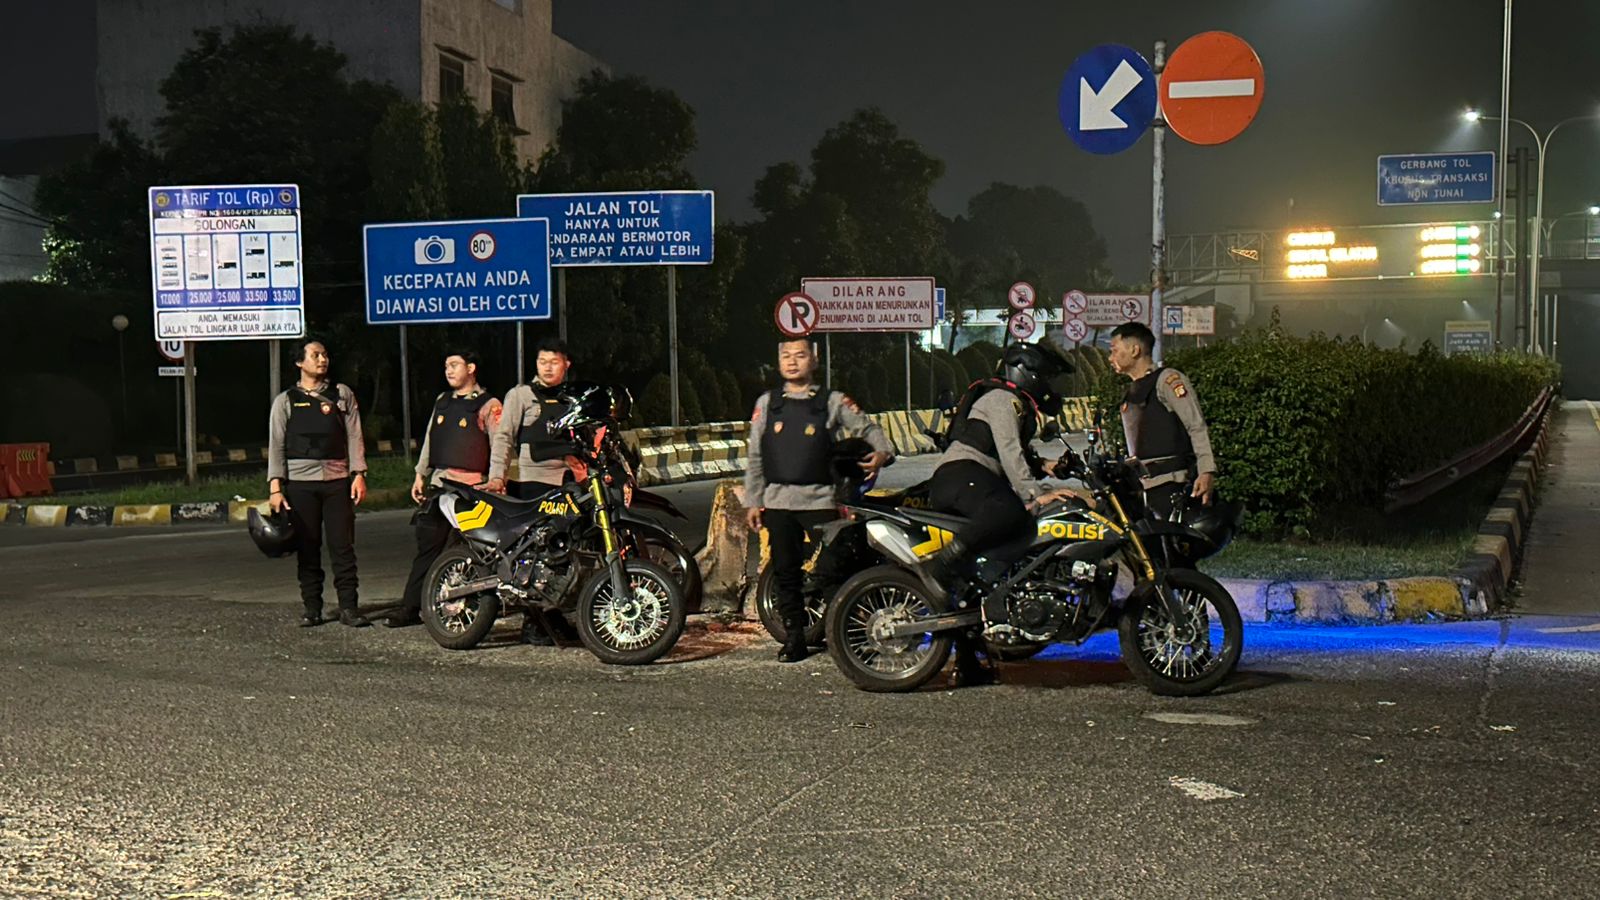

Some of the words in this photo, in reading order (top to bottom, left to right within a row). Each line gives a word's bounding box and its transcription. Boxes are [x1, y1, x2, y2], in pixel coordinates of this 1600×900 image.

[1400, 159, 1447, 169] GERBANG
[1453, 158, 1471, 168] TOL
[1431, 172, 1488, 183] TRANSAKSI
[174, 192, 210, 206] TARIF
[217, 191, 242, 205] TOL
[246, 189, 274, 208] (Rp)
[1407, 190, 1428, 198] NON
[1434, 188, 1464, 198] TUNAI
[565, 202, 620, 217] JALAN
[628, 200, 660, 214] TOL
[565, 218, 610, 230] HANYA
[617, 217, 660, 229] UNTUK
[622, 231, 691, 243] BERMOTOR
[473, 239, 486, 254] 80
[570, 246, 613, 258] EMPAT
[620, 245, 654, 257] ATAU
[661, 245, 701, 256] LEBIH
[383, 271, 476, 290] KECEPATAN
[484, 270, 531, 286] ANDA
[190, 292, 212, 303] 25.000
[217, 291, 241, 303] 25.000
[244, 290, 268, 302] 33.500
[272, 290, 297, 302] 33.500
[832, 286, 906, 297] DILARANG
[376, 297, 443, 314] DIAWASI
[448, 295, 490, 312] OLEH
[496, 293, 540, 310] CCTV
[856, 301, 873, 310] DAN
[876, 300, 930, 310] MENURUNKAN
[198, 314, 218, 323] ANDA
[222, 313, 260, 322] MEMASUKI
[820, 314, 865, 324] ENUMPANG
[867, 314, 876, 323] DI
[878, 313, 905, 323] JALAN
[908, 313, 924, 323] TOL
[163, 326, 188, 334] JALAN
[190, 325, 204, 334] TOL
[206, 324, 238, 333] LINGKAR
[240, 324, 260, 332] LUAR
[538, 500, 568, 516] POLISI
[1037, 522, 1105, 540] POLISI
